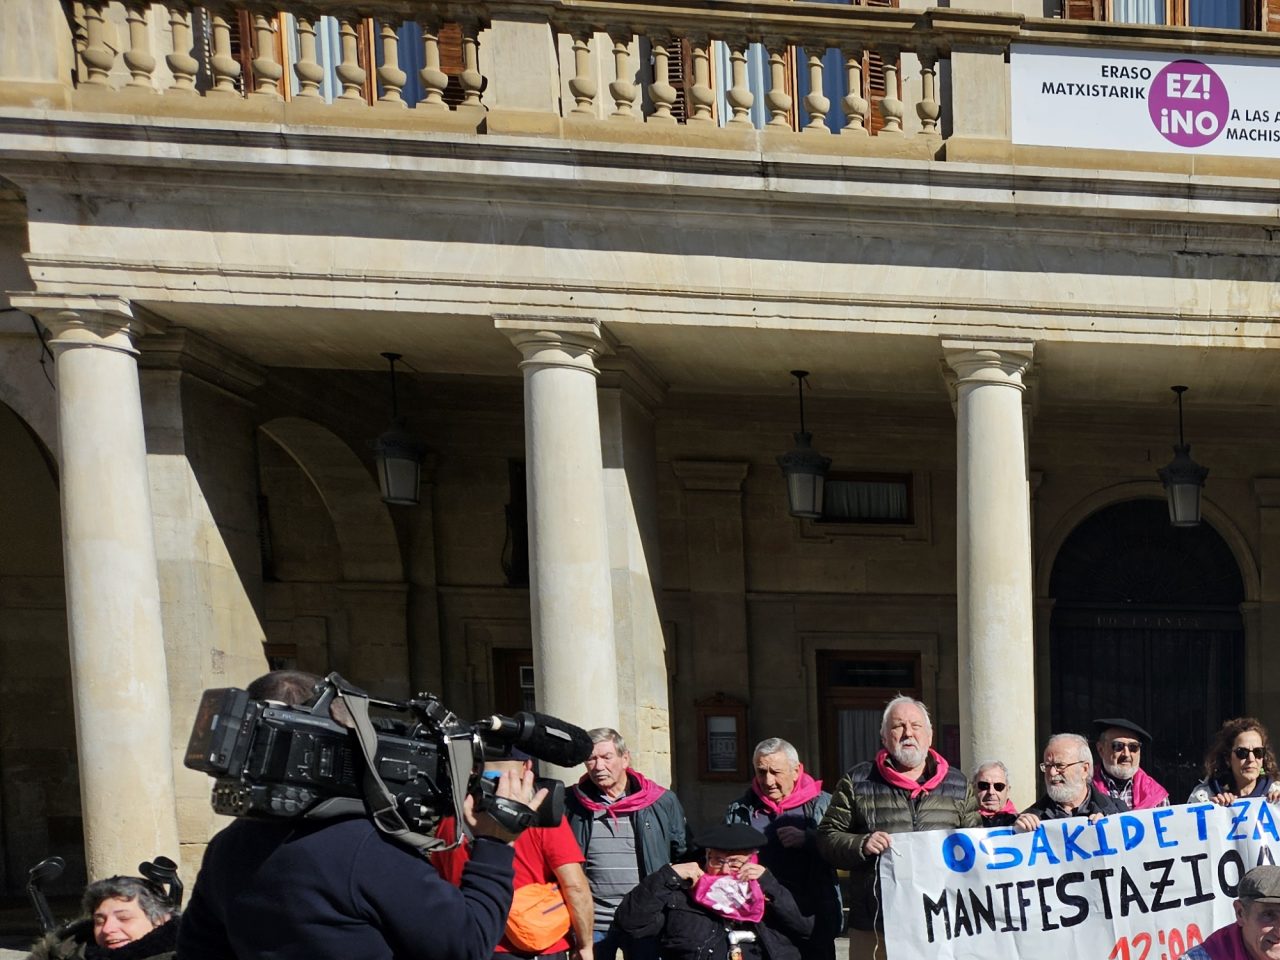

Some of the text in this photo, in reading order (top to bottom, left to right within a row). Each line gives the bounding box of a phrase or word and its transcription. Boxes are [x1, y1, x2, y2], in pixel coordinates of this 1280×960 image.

[1102, 65, 1151, 80] ERASO
[1042, 82, 1145, 99] MATXISTARIK
[1166, 73, 1211, 99] EZ!
[1160, 108, 1218, 135] ¡NO
[1231, 109, 1240, 121] A
[1245, 110, 1269, 122] LAS
[942, 801, 1280, 873] OSAKIDETZA
